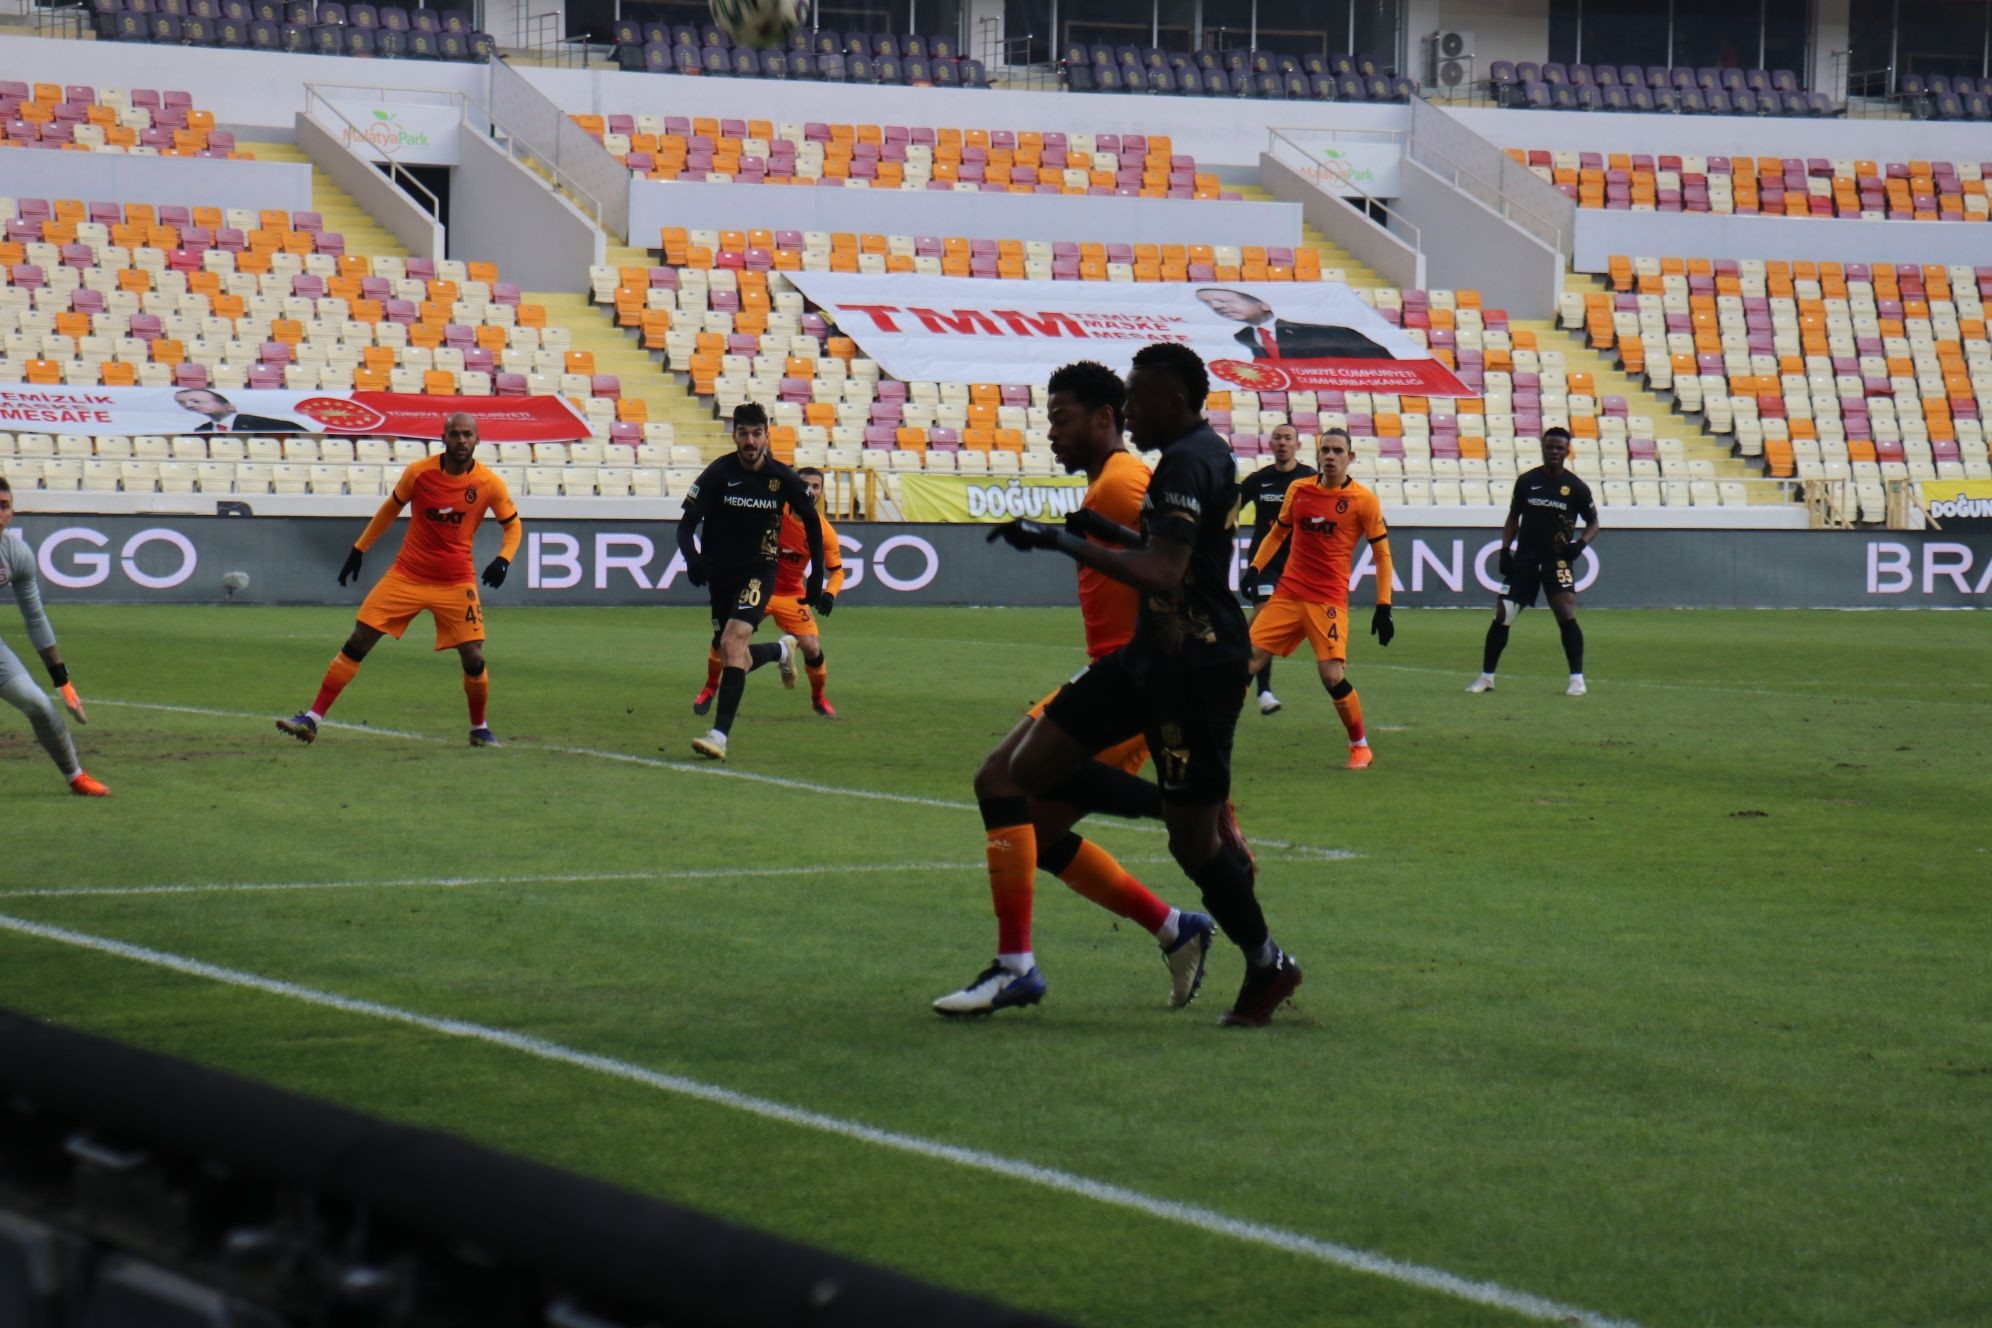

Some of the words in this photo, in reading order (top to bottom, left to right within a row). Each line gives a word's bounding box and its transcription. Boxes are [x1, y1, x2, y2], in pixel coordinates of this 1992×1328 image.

[834, 304, 1091, 338] TMM
[1083, 320, 1171, 332] MASKE
[0, 409, 112, 422] MESAFE
[1556, 569, 1574, 583] 55
[739, 588, 762, 607] 90
[1327, 622, 1340, 642] 4
